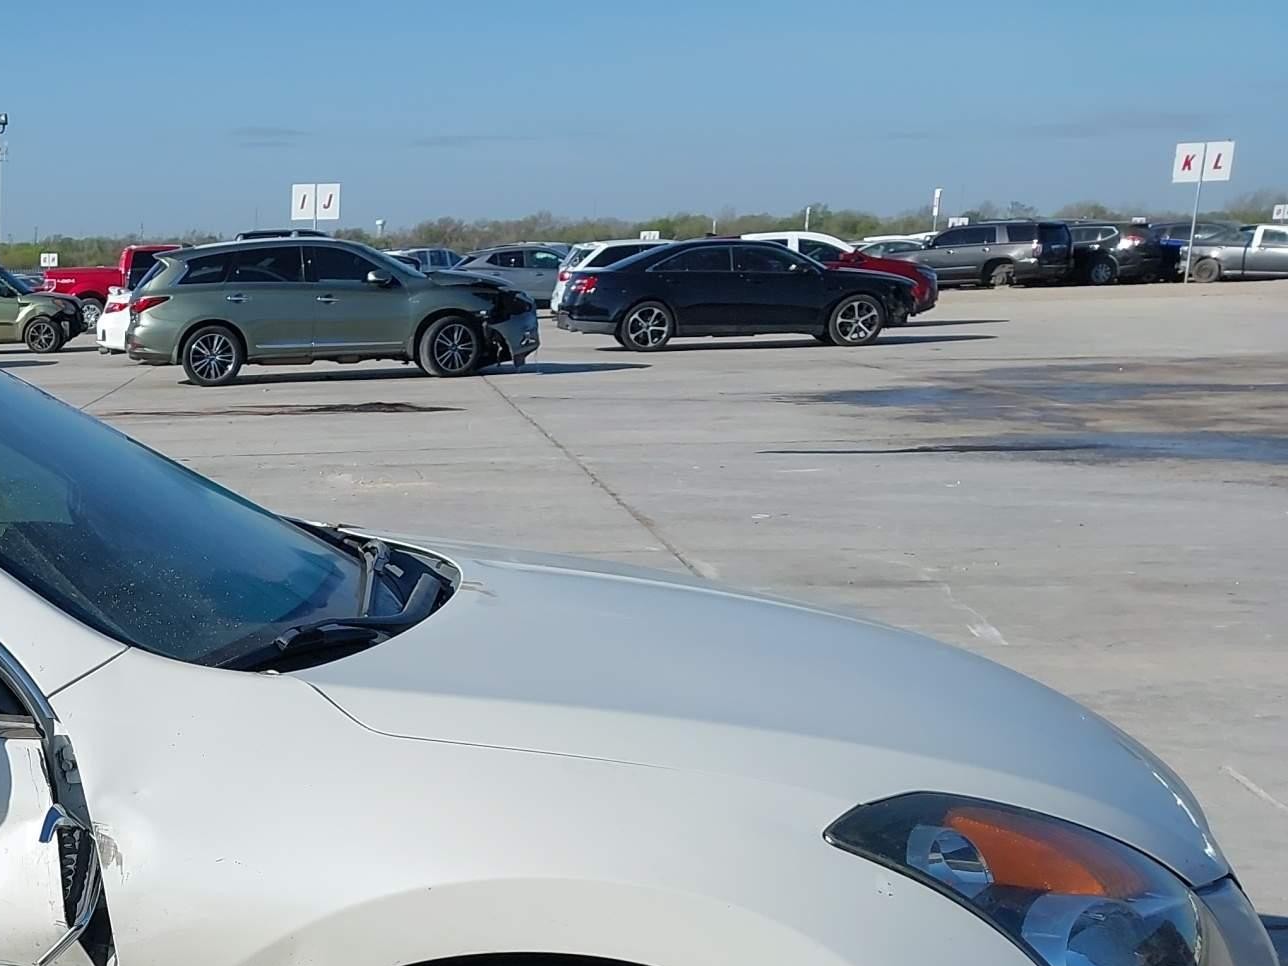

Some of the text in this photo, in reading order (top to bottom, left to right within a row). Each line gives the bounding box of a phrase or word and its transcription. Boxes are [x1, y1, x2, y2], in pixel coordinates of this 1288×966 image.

[1181, 153, 1222, 171] K L
[300, 193, 333, 210] I J
